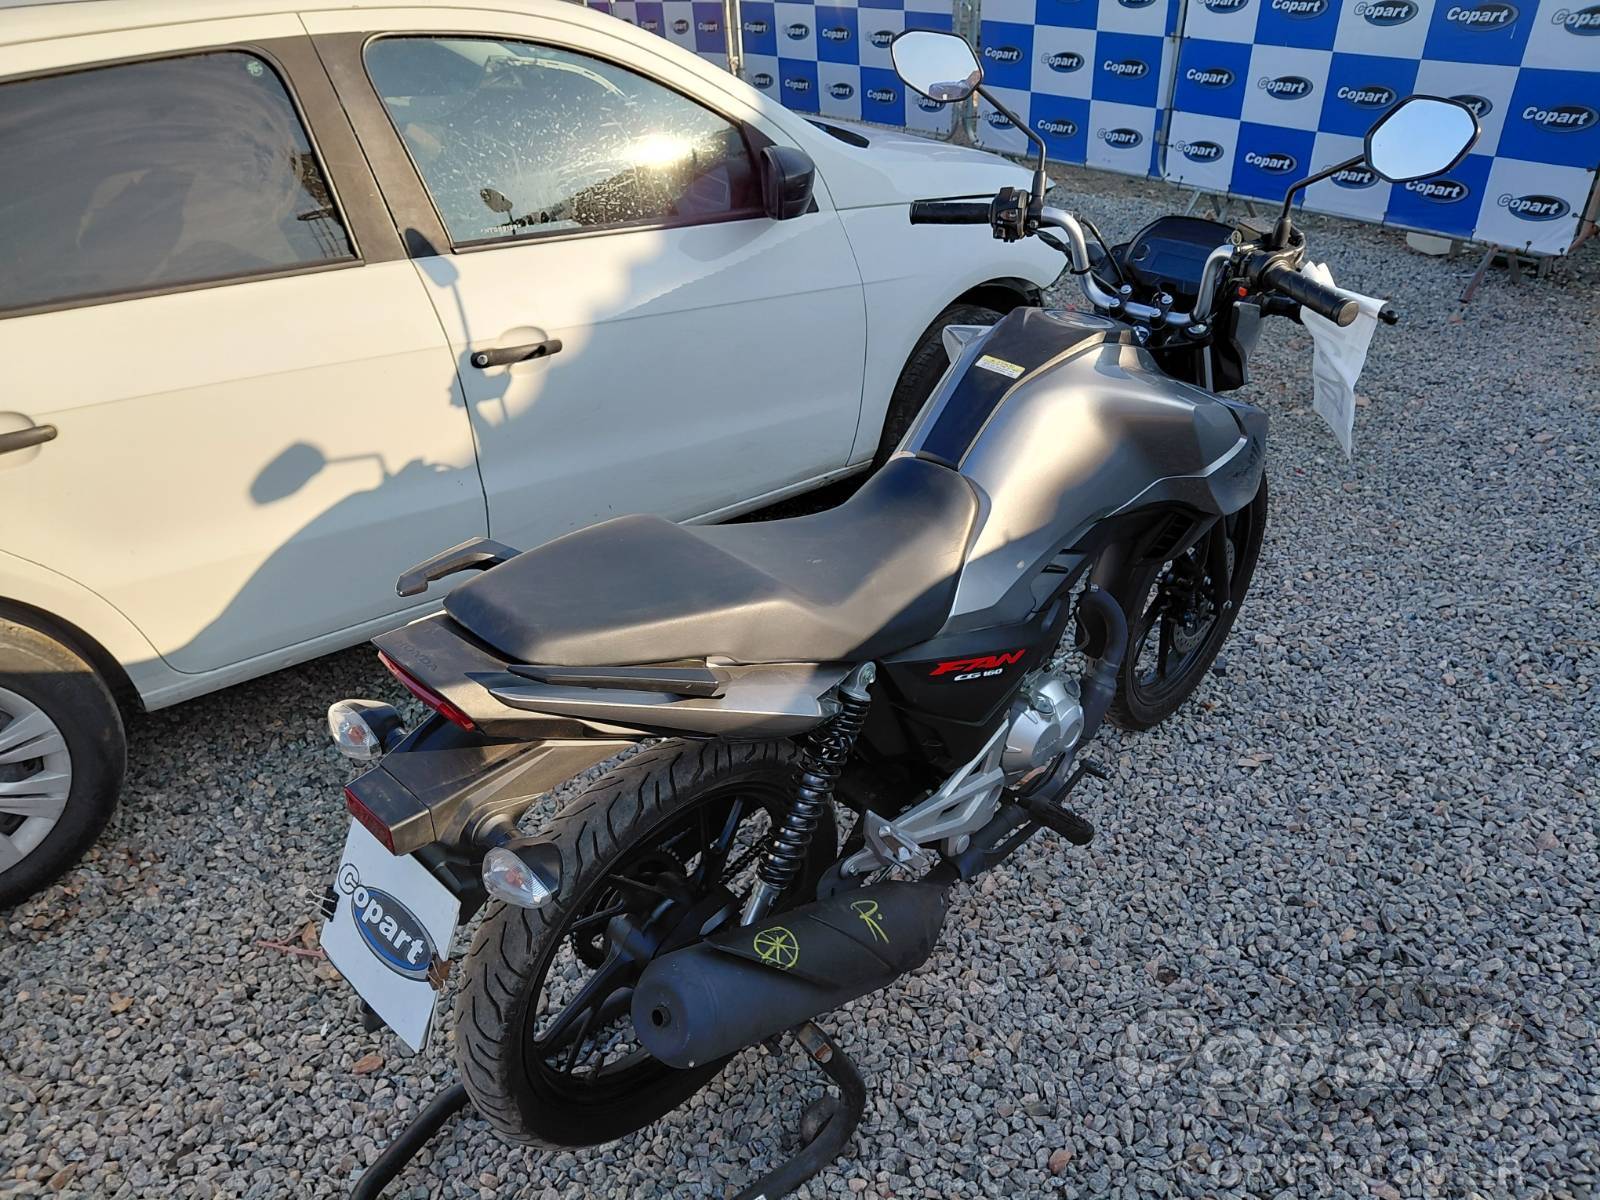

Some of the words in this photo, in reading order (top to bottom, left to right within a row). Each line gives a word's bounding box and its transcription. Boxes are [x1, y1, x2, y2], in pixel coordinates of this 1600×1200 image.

[1271, 0, 1320, 13] Copart
[1355, 0, 1409, 18] Copart
[1446, 6, 1509, 25] Copart
[744, 22, 767, 33] Copart
[822, 28, 848, 39] Copart
[984, 47, 1018, 60] Copart
[1041, 53, 1078, 68] Copart
[1103, 60, 1143, 75] Copart
[1186, 68, 1229, 84] Copart
[784, 78, 809, 91] Copart
[1258, 77, 1305, 94] Copart
[867, 89, 893, 102] Copart
[1337, 86, 1389, 104] Copart
[982, 111, 1014, 124] Copar
[1523, 106, 1589, 126] Copart
[1037, 119, 1073, 135] Copart
[1097, 128, 1137, 144] Copart
[1176, 140, 1217, 157] Copart
[1245, 152, 1291, 170] Copart
[1405, 180, 1460, 198] Copart
[1497, 194, 1560, 215] Copart
[929, 648, 1025, 676] FAN
[954, 671, 981, 682] CG
[338, 862, 425, 966] Copart
